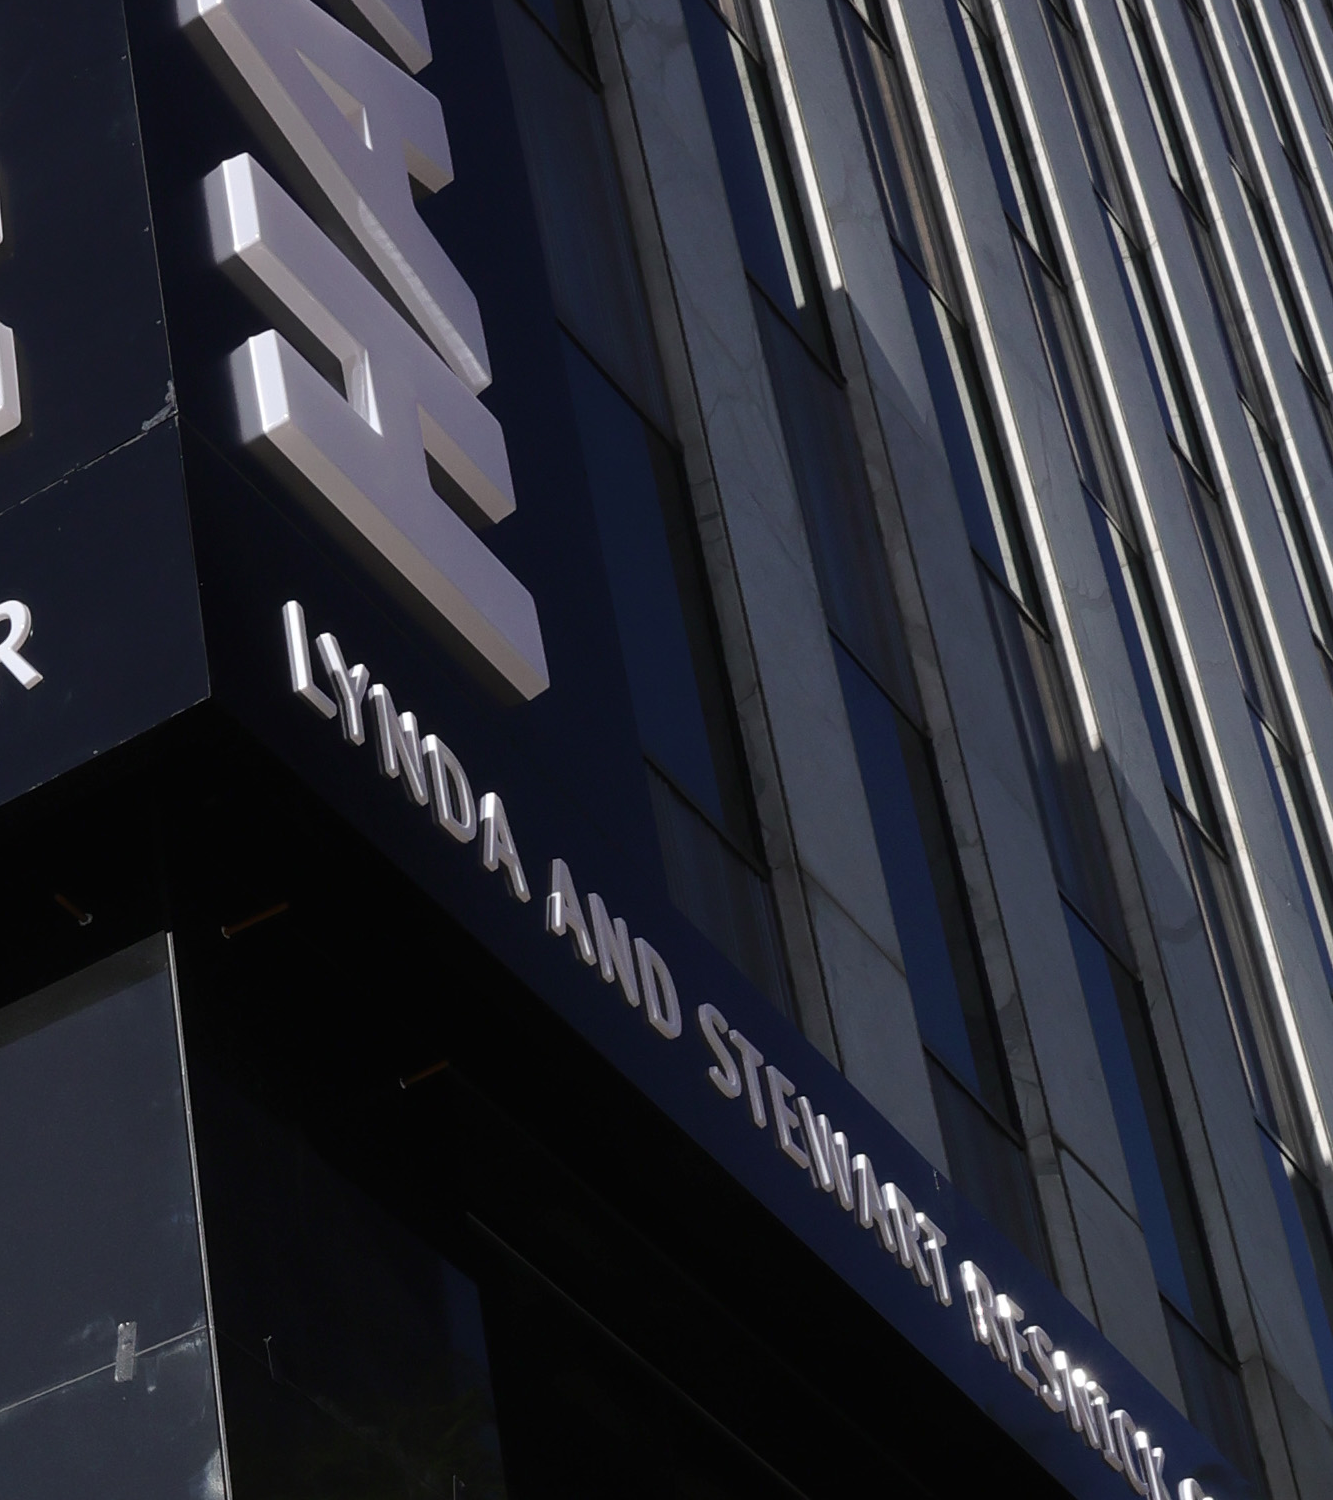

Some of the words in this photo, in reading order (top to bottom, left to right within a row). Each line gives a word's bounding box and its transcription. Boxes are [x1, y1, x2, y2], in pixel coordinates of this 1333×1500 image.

[281, 599, 532, 903] LYNDA
[545, 857, 683, 1040] AND
[697, 1002, 954, 1308] STEWART
